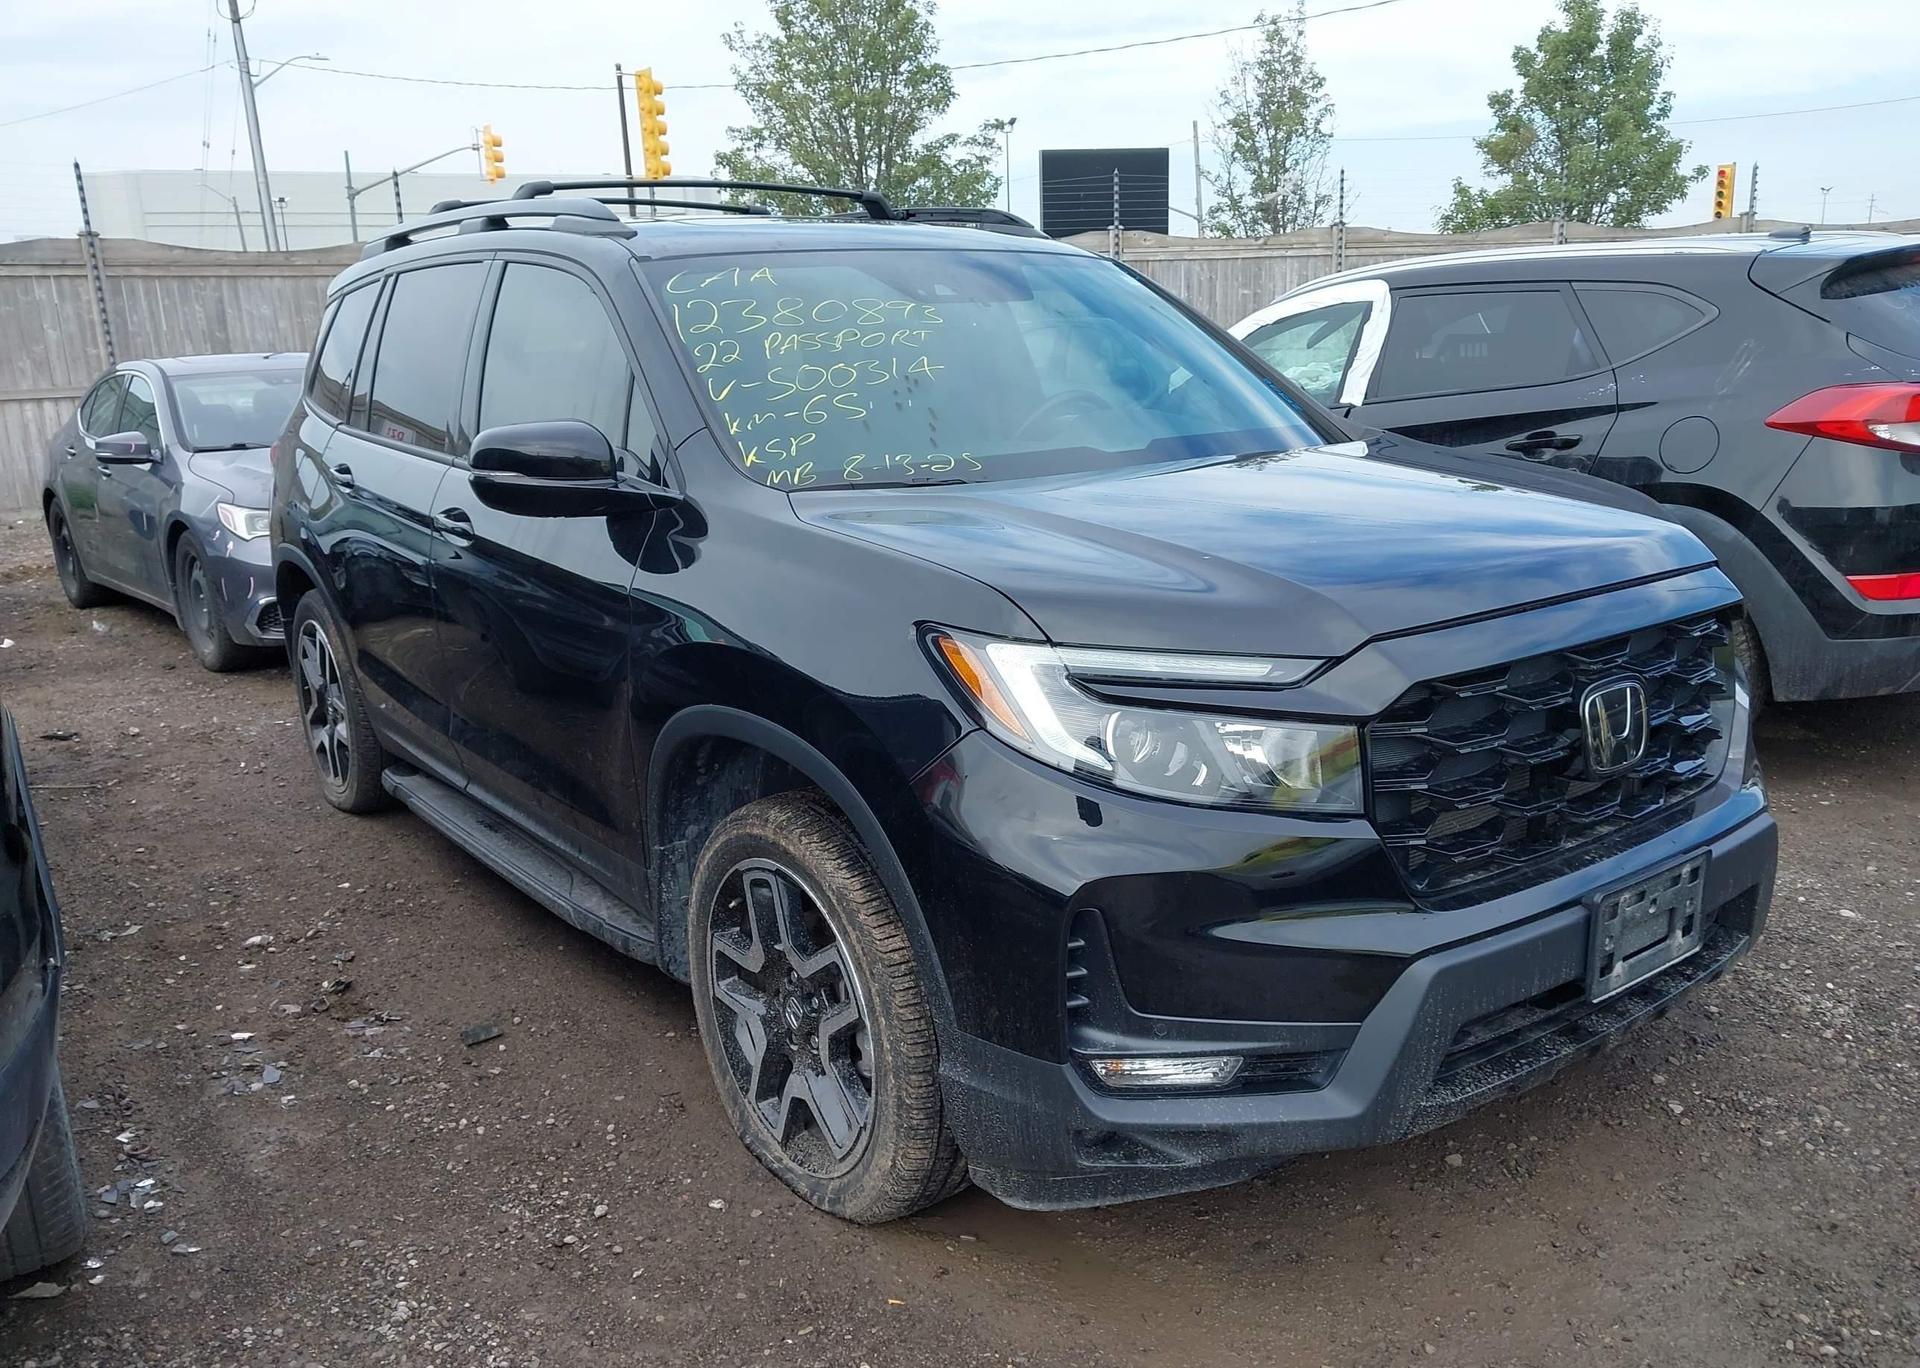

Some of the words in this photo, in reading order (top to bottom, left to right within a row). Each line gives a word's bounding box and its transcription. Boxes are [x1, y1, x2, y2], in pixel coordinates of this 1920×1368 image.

[666, 266, 778, 294] CAA
[673, 297, 944, 345] 12380893
[694, 339, 743, 373] 22
[764, 328, 937, 360] PASSPORT
[766, 461, 817, 486] MB
[843, 452, 983, 481] 8-13-25
